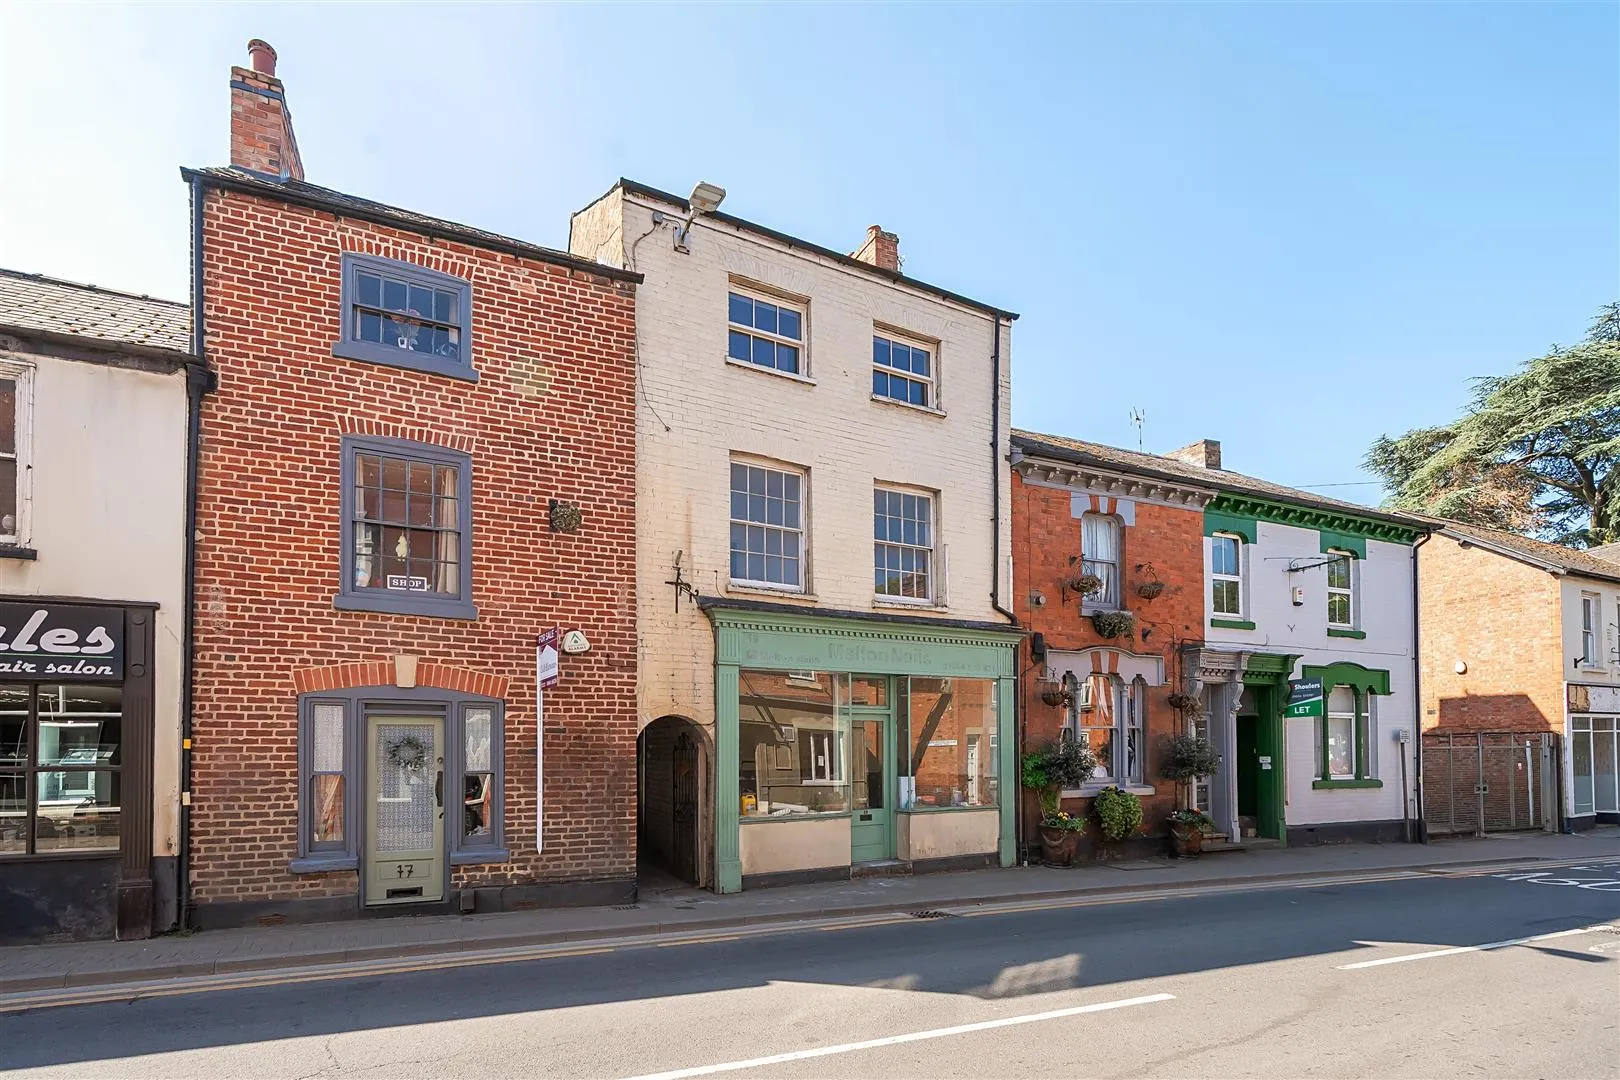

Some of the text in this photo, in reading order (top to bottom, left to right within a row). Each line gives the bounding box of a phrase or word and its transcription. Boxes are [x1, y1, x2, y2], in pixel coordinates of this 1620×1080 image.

[392, 578, 422, 588] SHOP
[0, 609, 115, 654] les
[891, 647, 932, 665] Nails
[44, 660, 114, 675] salon
[1294, 705, 1311, 714] LET
[396, 864, 414, 879] 17
